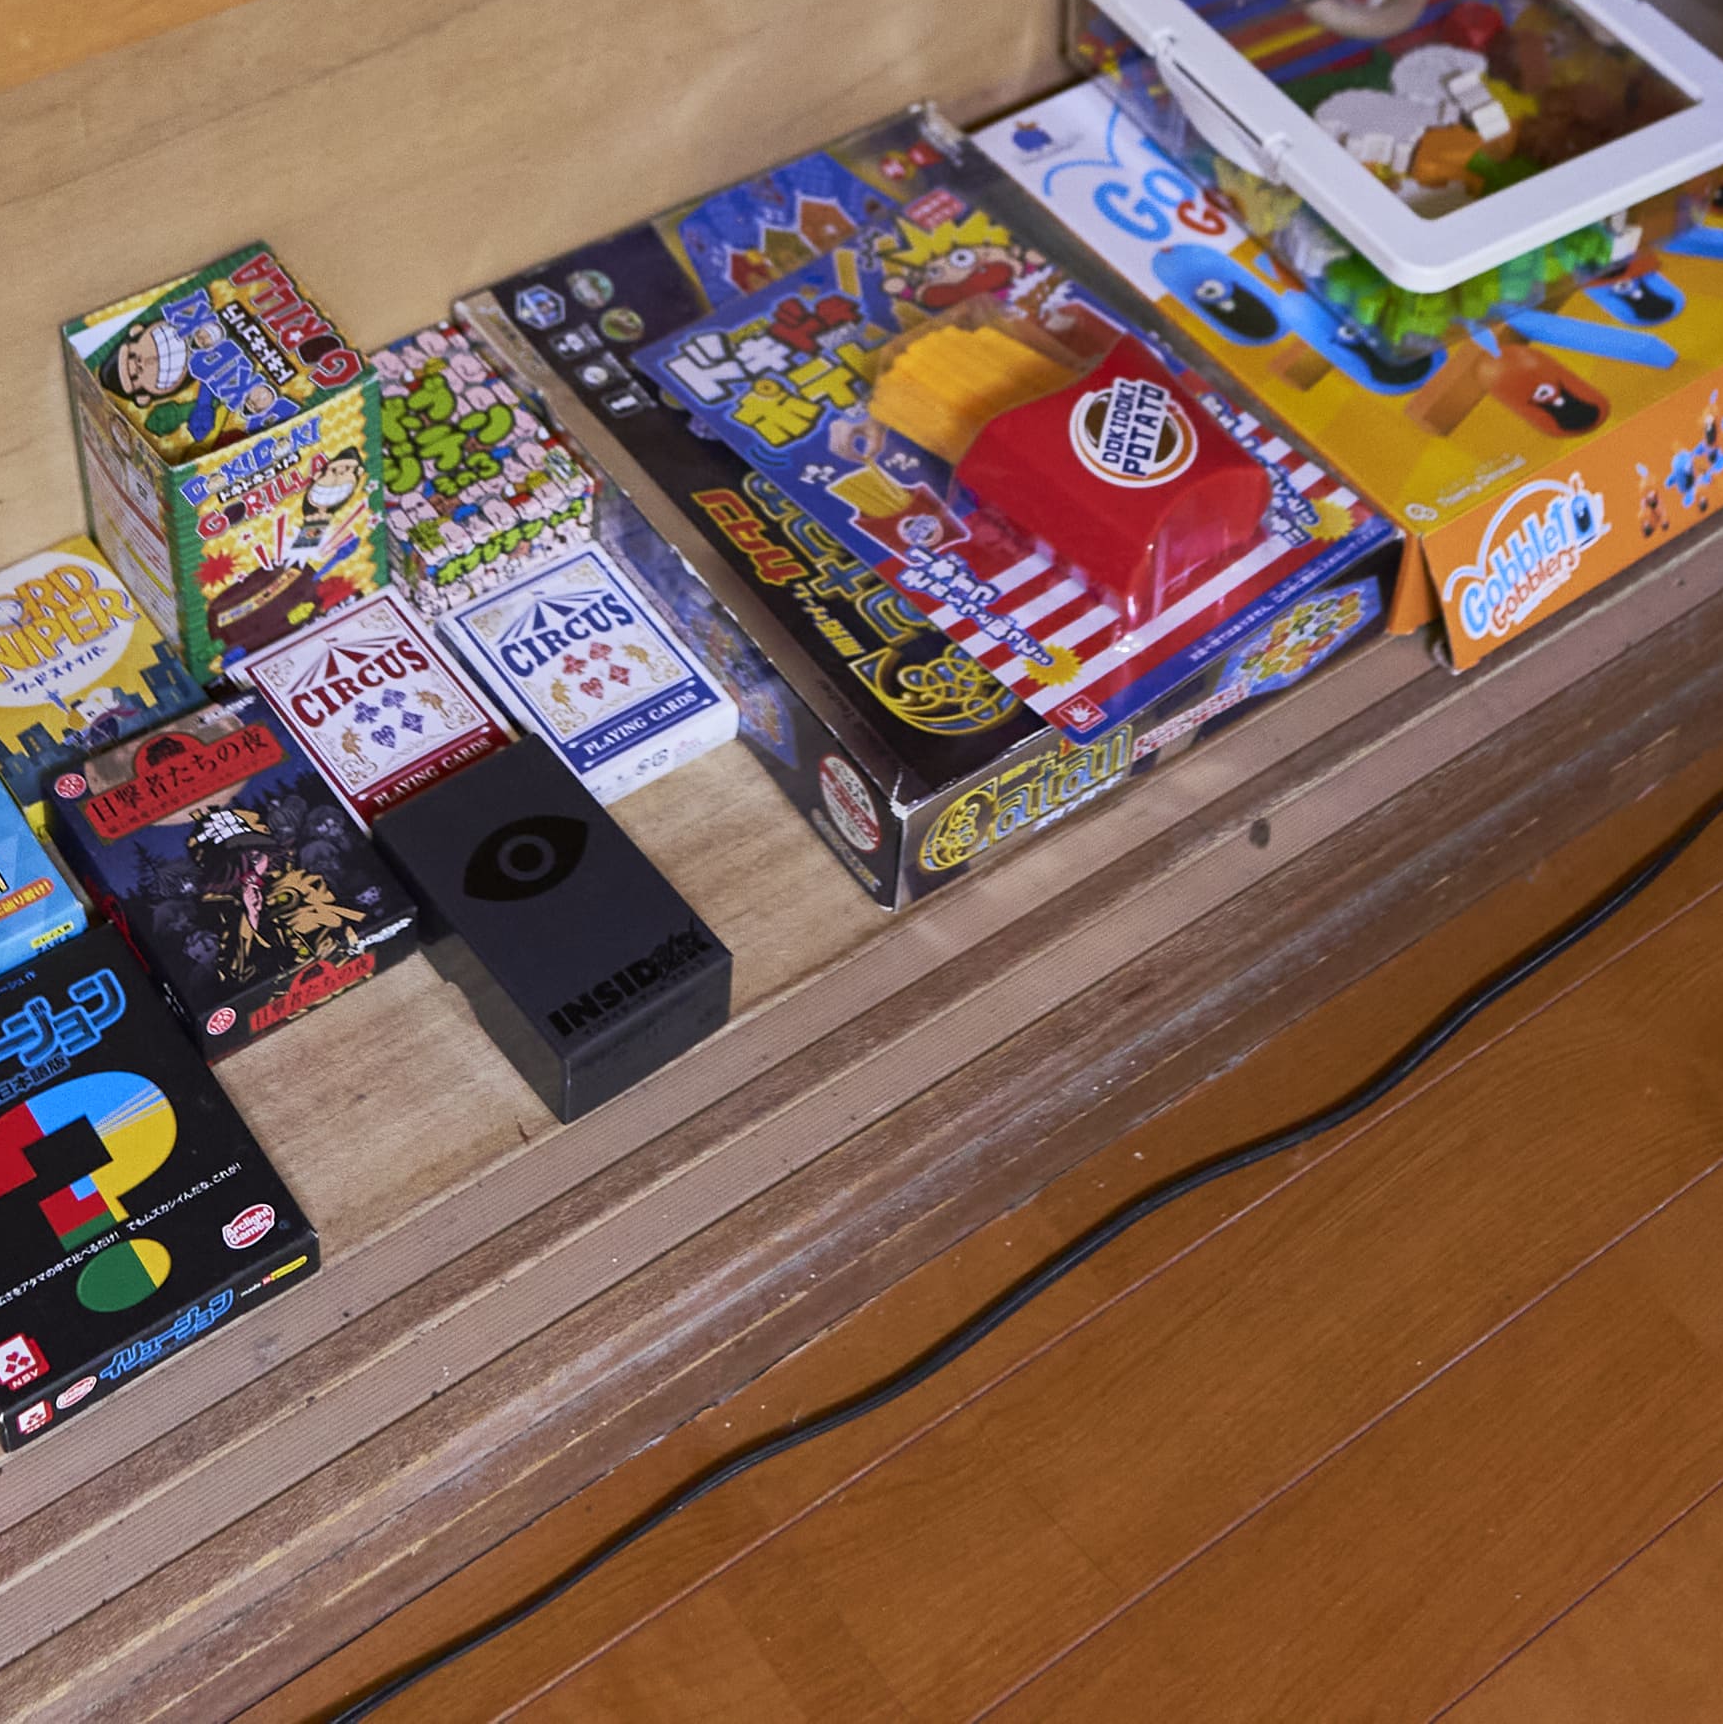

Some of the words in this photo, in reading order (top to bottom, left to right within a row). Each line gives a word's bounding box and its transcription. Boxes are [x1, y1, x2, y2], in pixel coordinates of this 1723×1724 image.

[230, 251, 363, 392] GORILLA
[1101, 378, 1139, 465] DOKIDOKI
[1123, 380, 1167, 477] POTATO
[196, 452, 328, 541] GORILLA
[689, 486, 807, 587] カタン
[499, 591, 636, 678] CIRCUS
[290, 636, 431, 730] CIRCUS
[581, 711, 647, 757] PLAYING
[648, 687, 700, 723] CARDS
[90, 729, 271, 823] 目撃者たちの夜
[372, 762, 439, 808] PLAYING
[917, 722, 1133, 873] Catan
[224, 1205, 274, 1240] Arclight
[227, 1221, 275, 1248] Games
[100, 1287, 234, 1380] イリュージョン
[11, 1367, 40, 1391] NSV
